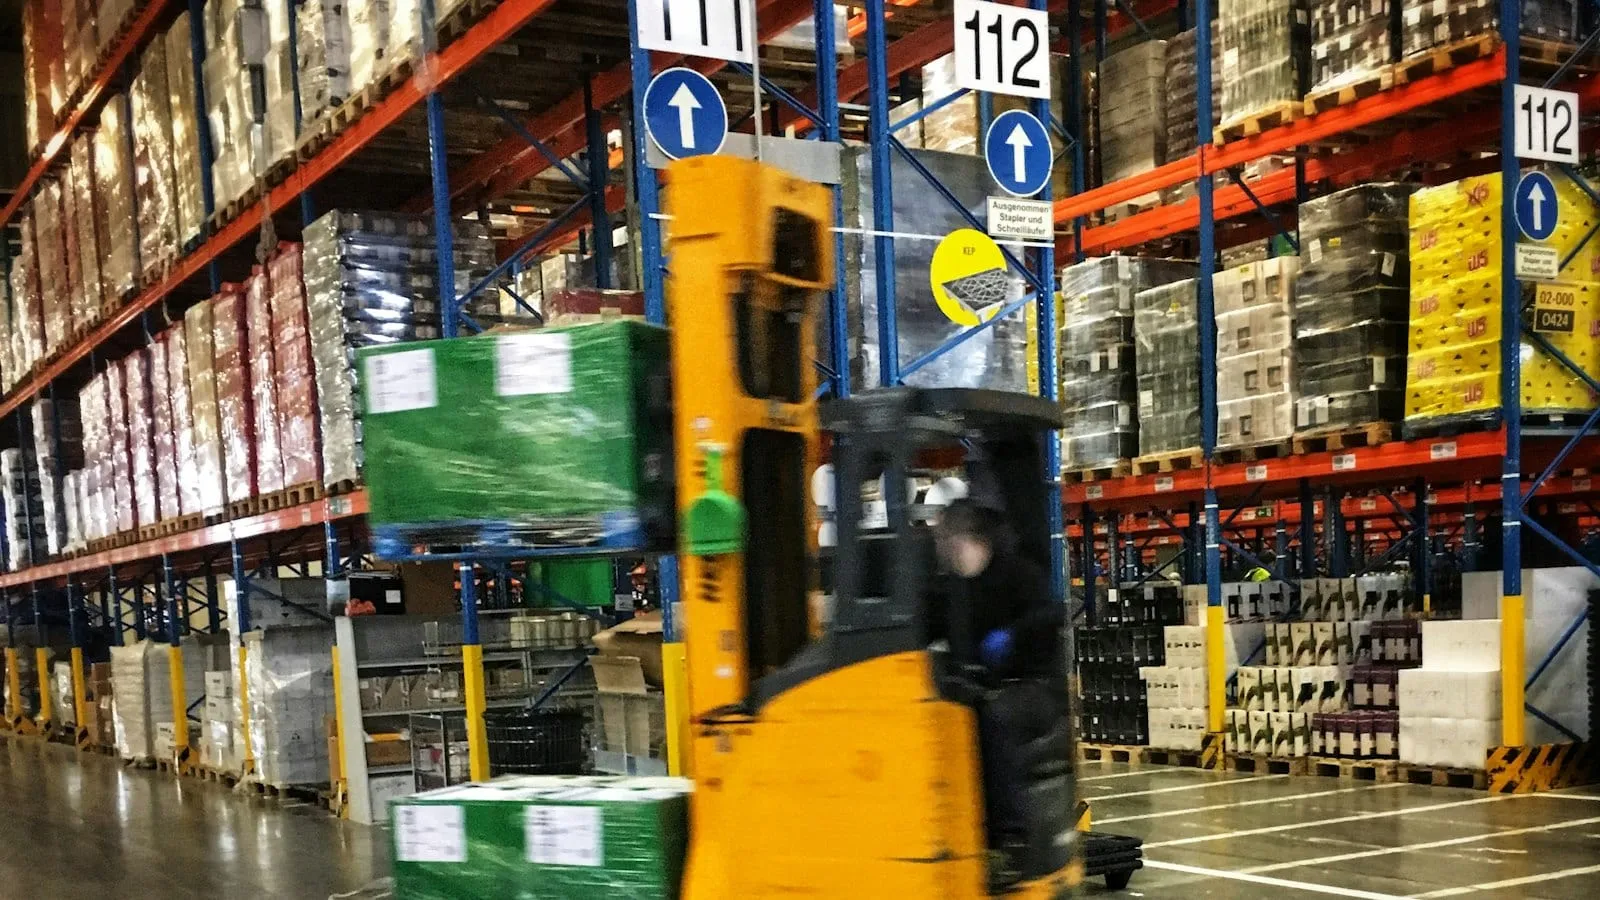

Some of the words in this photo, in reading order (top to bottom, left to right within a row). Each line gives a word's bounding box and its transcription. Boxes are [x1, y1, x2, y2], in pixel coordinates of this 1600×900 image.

[965, 10, 1040, 88] 112
[1521, 94, 1572, 155] 112
[992, 201, 1049, 213] Ausgenommen
[999, 212, 1026, 223] Stapler
[1028, 215, 1043, 224] und
[1540, 291, 1575, 306] 02-000
